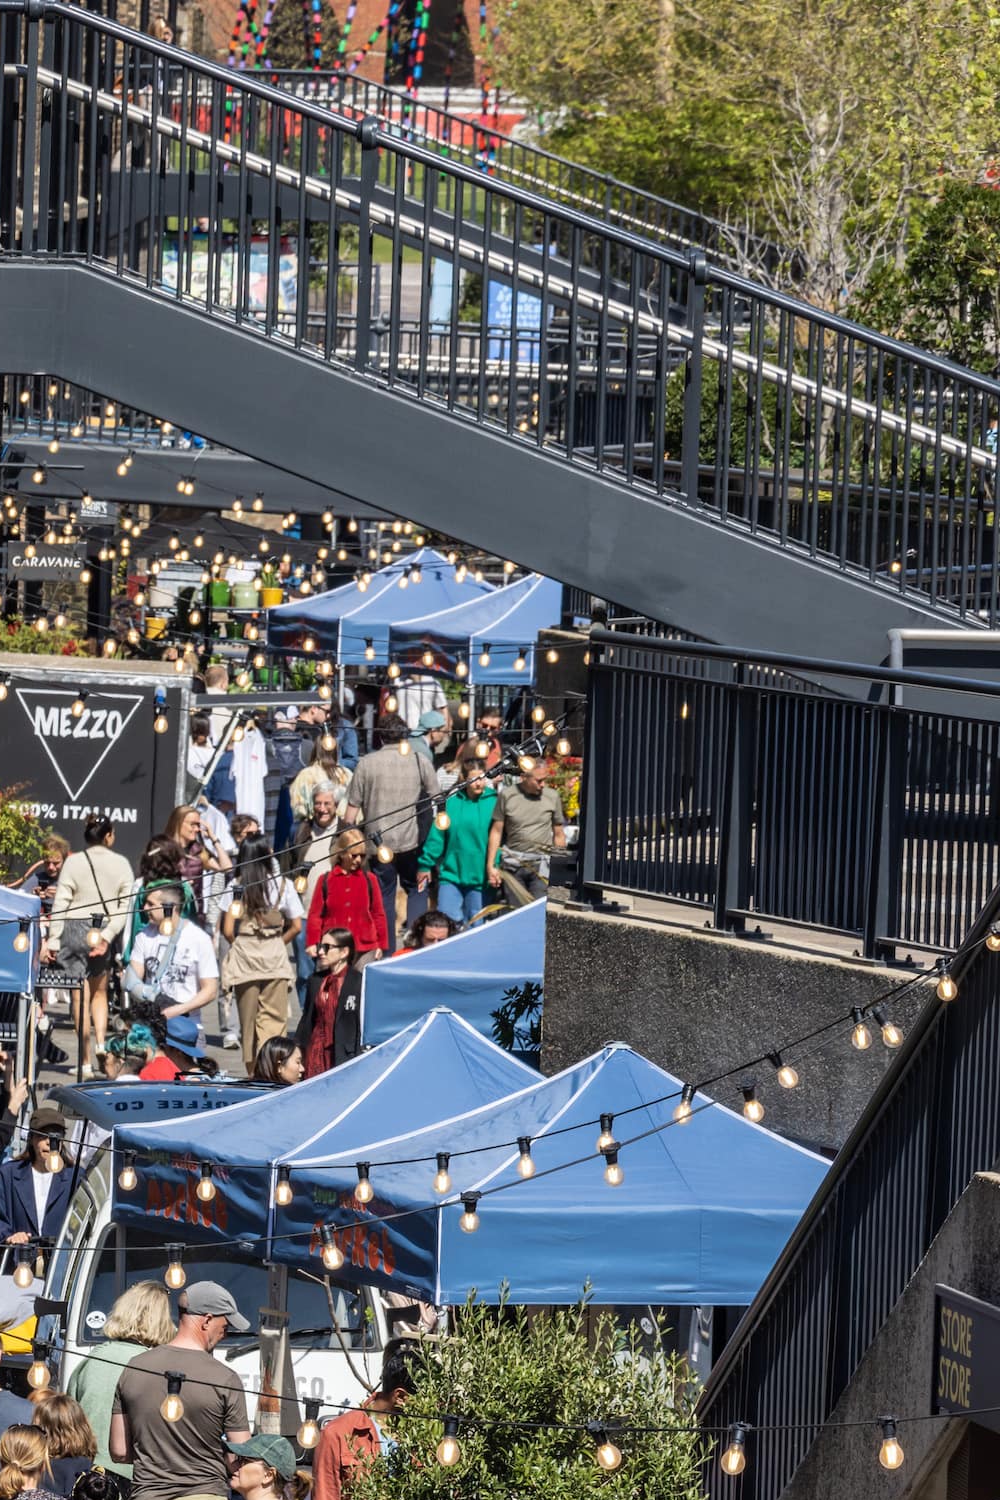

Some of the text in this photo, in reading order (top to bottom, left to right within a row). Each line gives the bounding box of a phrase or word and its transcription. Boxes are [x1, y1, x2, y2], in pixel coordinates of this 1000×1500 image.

[34, 705, 123, 739] MEZZO
[156, 1099, 240, 1111] OFFEE
[940, 1306, 973, 1358] STORE
[938, 1355, 971, 1409] STORE
